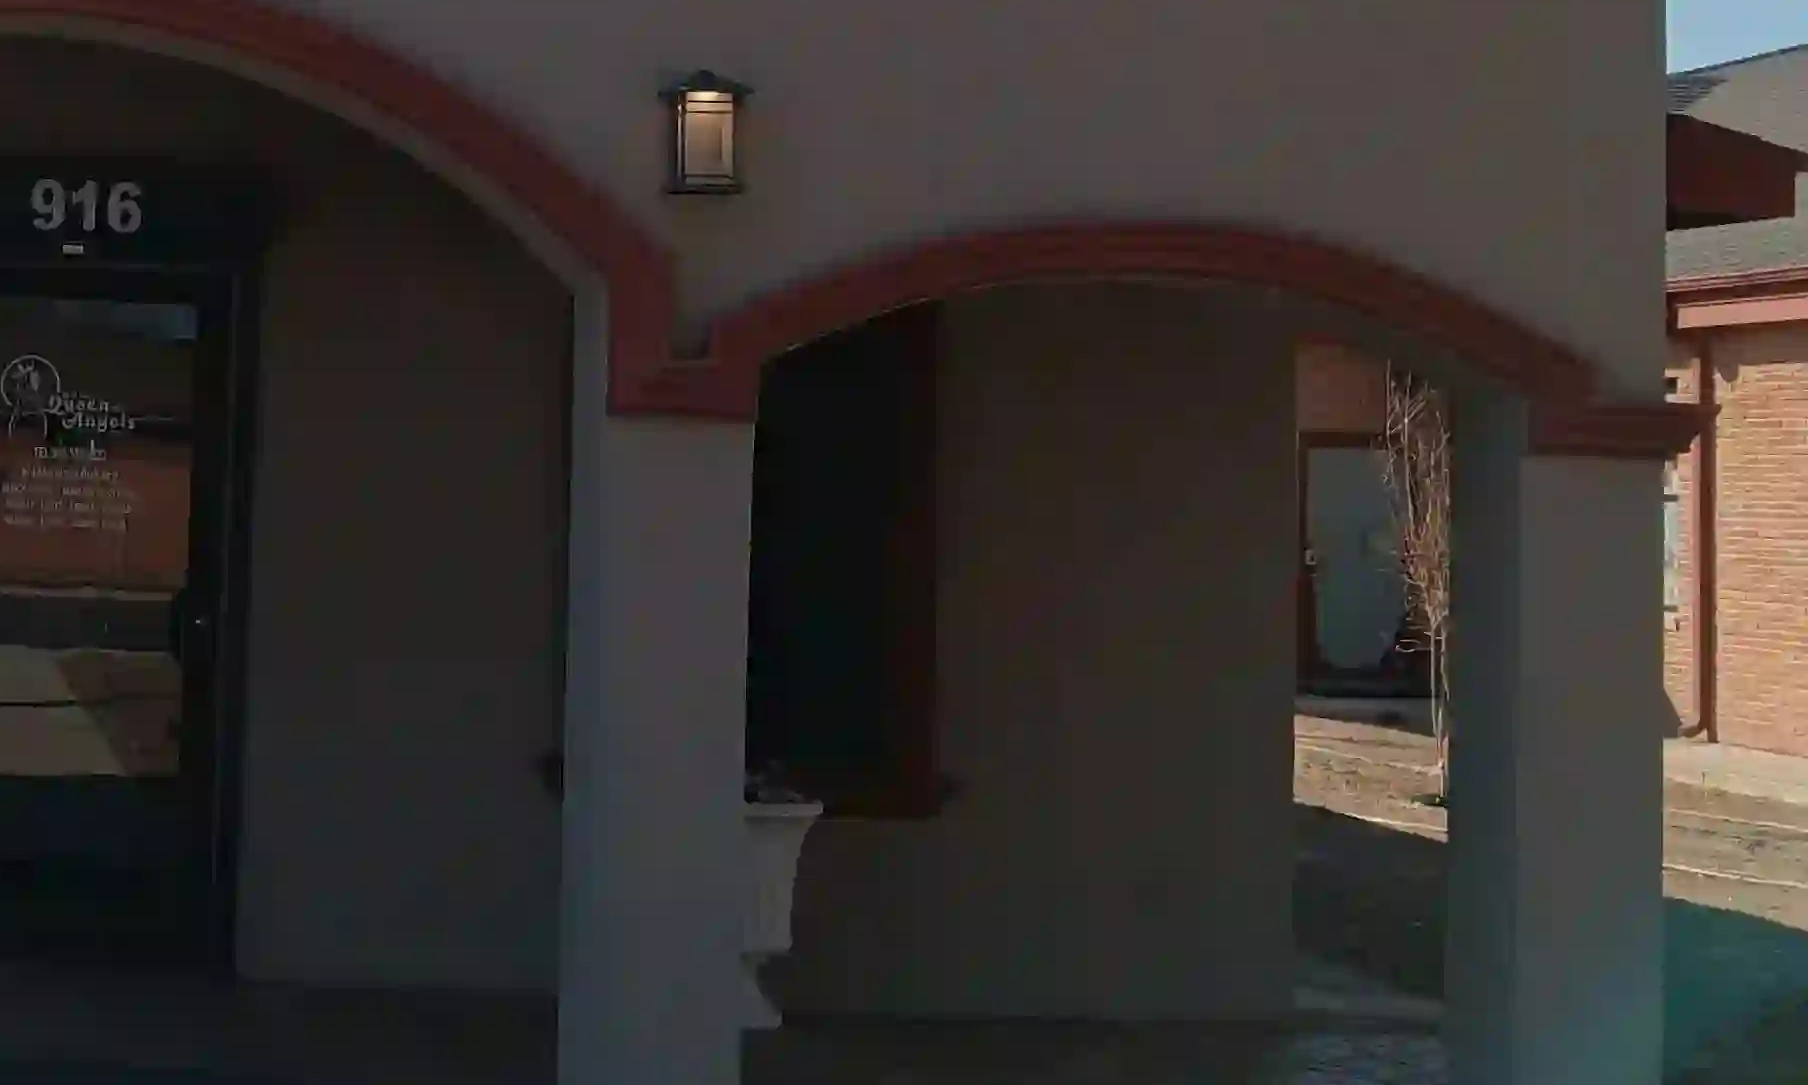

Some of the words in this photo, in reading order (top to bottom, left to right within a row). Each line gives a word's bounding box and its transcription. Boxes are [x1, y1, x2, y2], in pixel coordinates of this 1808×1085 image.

[30, 178, 145, 234] 916
[48, 394, 110, 415] Queen
[61, 412, 138, 432] Angels
